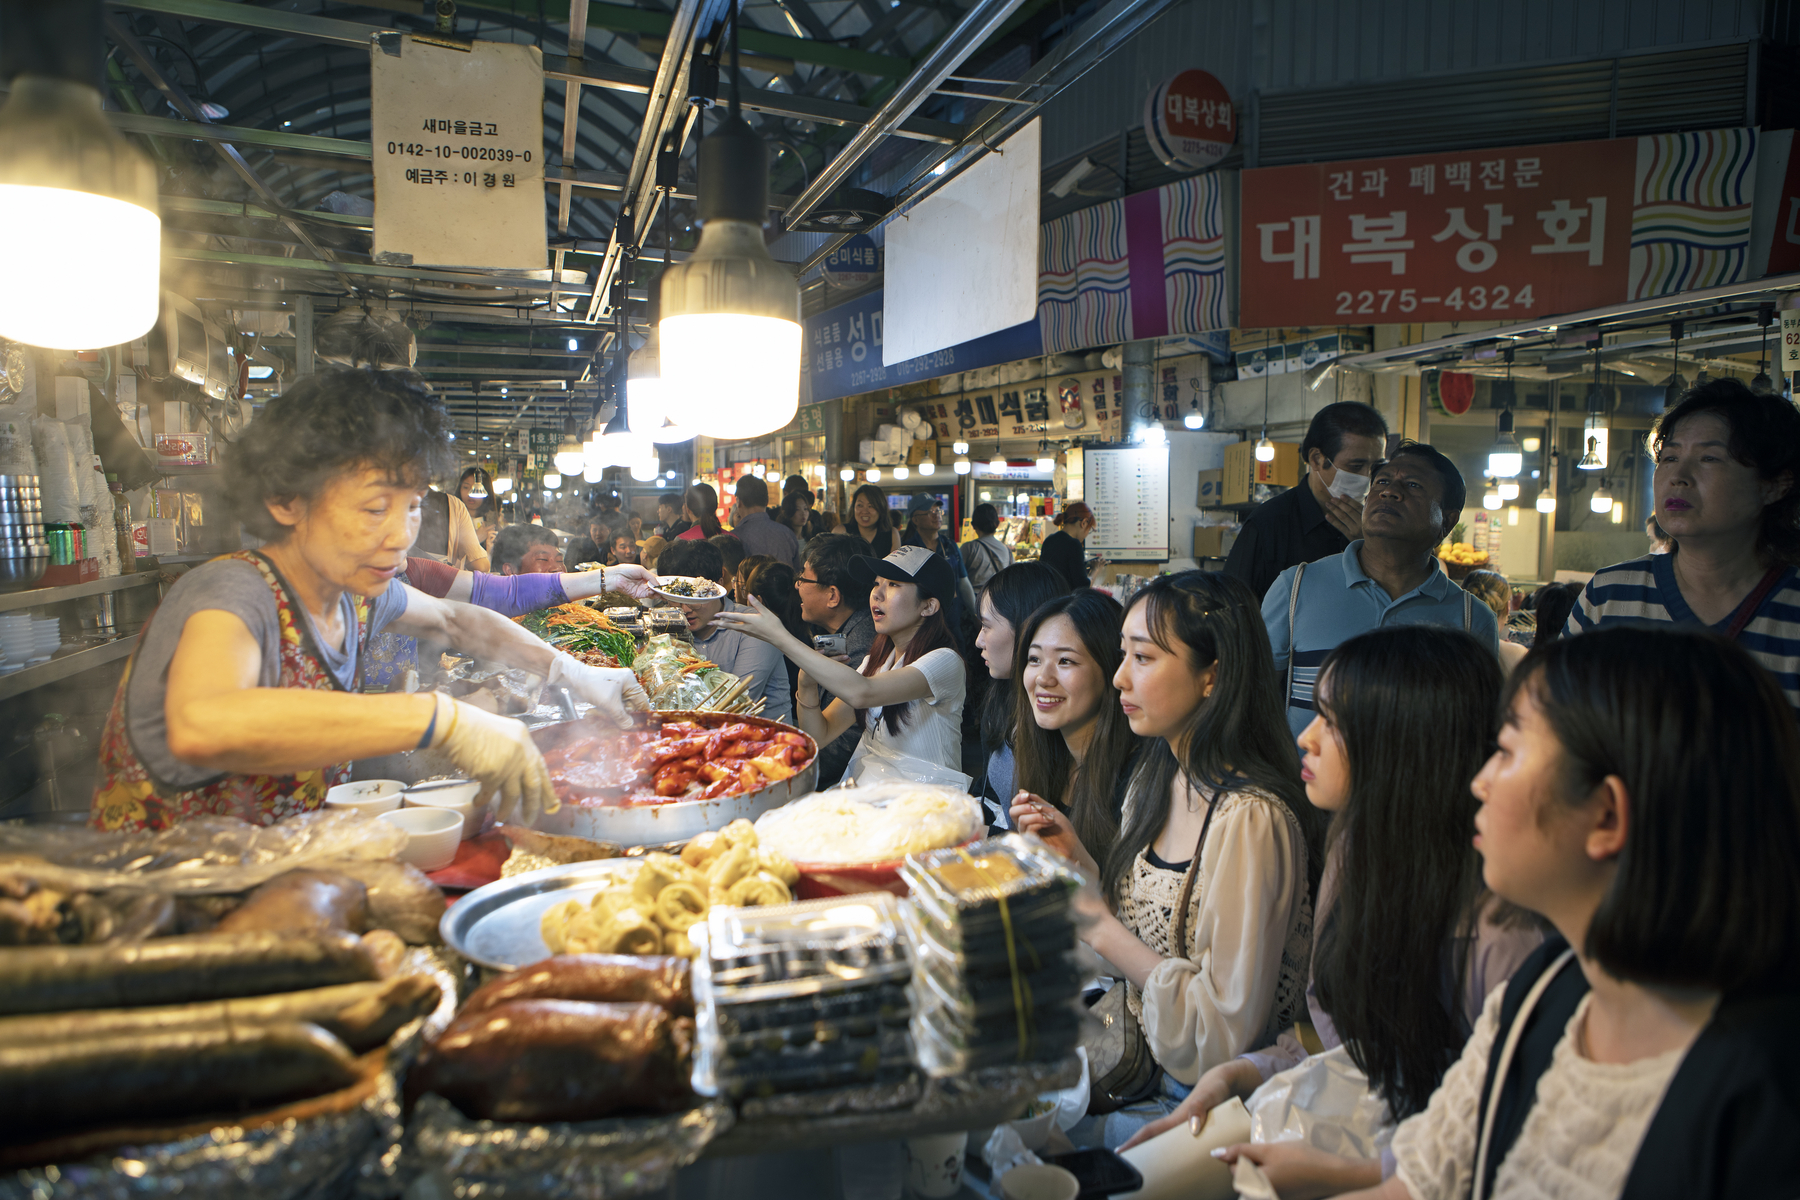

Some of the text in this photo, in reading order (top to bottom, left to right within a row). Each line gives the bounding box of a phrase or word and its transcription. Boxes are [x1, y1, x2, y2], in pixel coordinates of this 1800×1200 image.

[1167, 93, 1232, 132] 대복상회
[422, 118, 498, 136] 새마을금고
[387, 141, 532, 162] 0142-10-002039-0
[405, 168, 448, 185] 예금주
[1327, 157, 1544, 200] 건과 폐백전문
[1256, 196, 1607, 280] 대복상회
[1335, 284, 1535, 315] 2275-4324
[814, 322, 841, 348] 식료품
[816, 346, 843, 373] 선물용
[1788, 349, 1799, 361] 호
[851, 366, 887, 387] 2267-2928
[953, 387, 1050, 429] 성미식품
[158, 441, 189, 452] 모나리자
